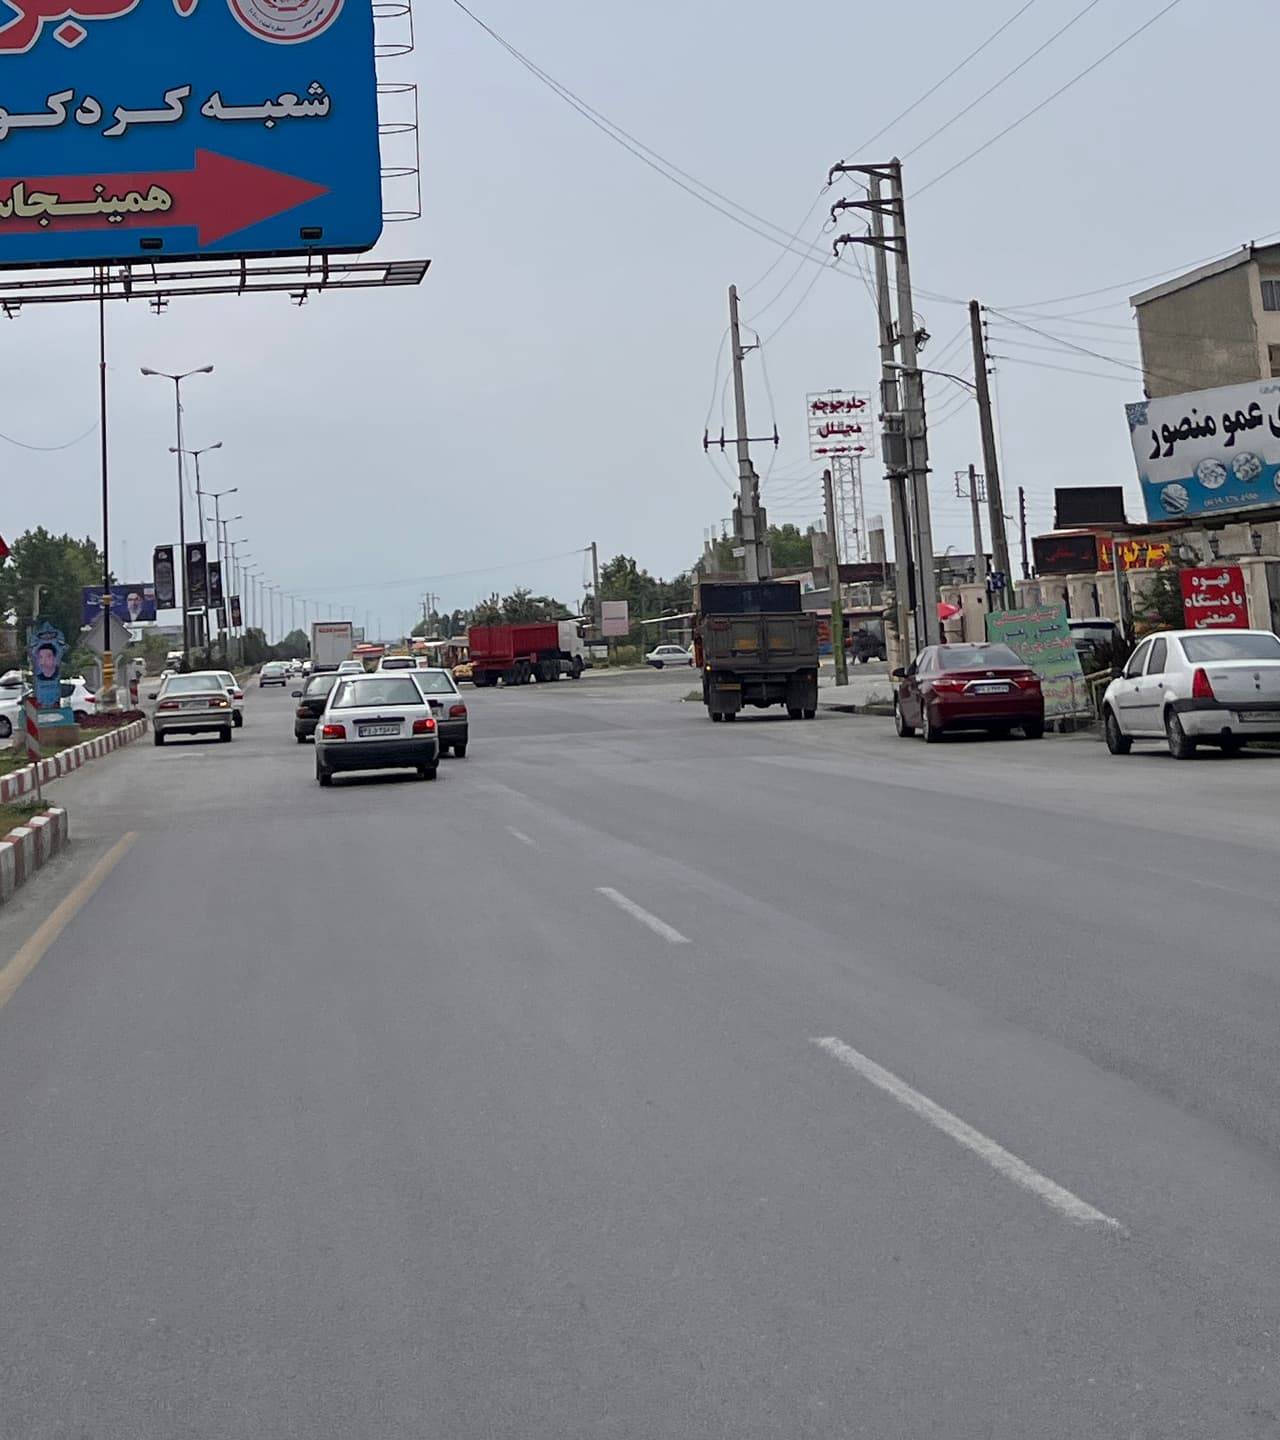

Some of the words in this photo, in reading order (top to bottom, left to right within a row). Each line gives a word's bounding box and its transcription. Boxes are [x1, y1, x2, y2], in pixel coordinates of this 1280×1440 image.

[200, 81, 331, 129] شعبه
[1149, 408, 1217, 460] منصور
[1223, 401, 1263, 448] عمو
[1191, 569, 1230, 590] قهوه
[1184, 593, 1230, 607] دستگاه
[1232, 591, 1243, 608] با
